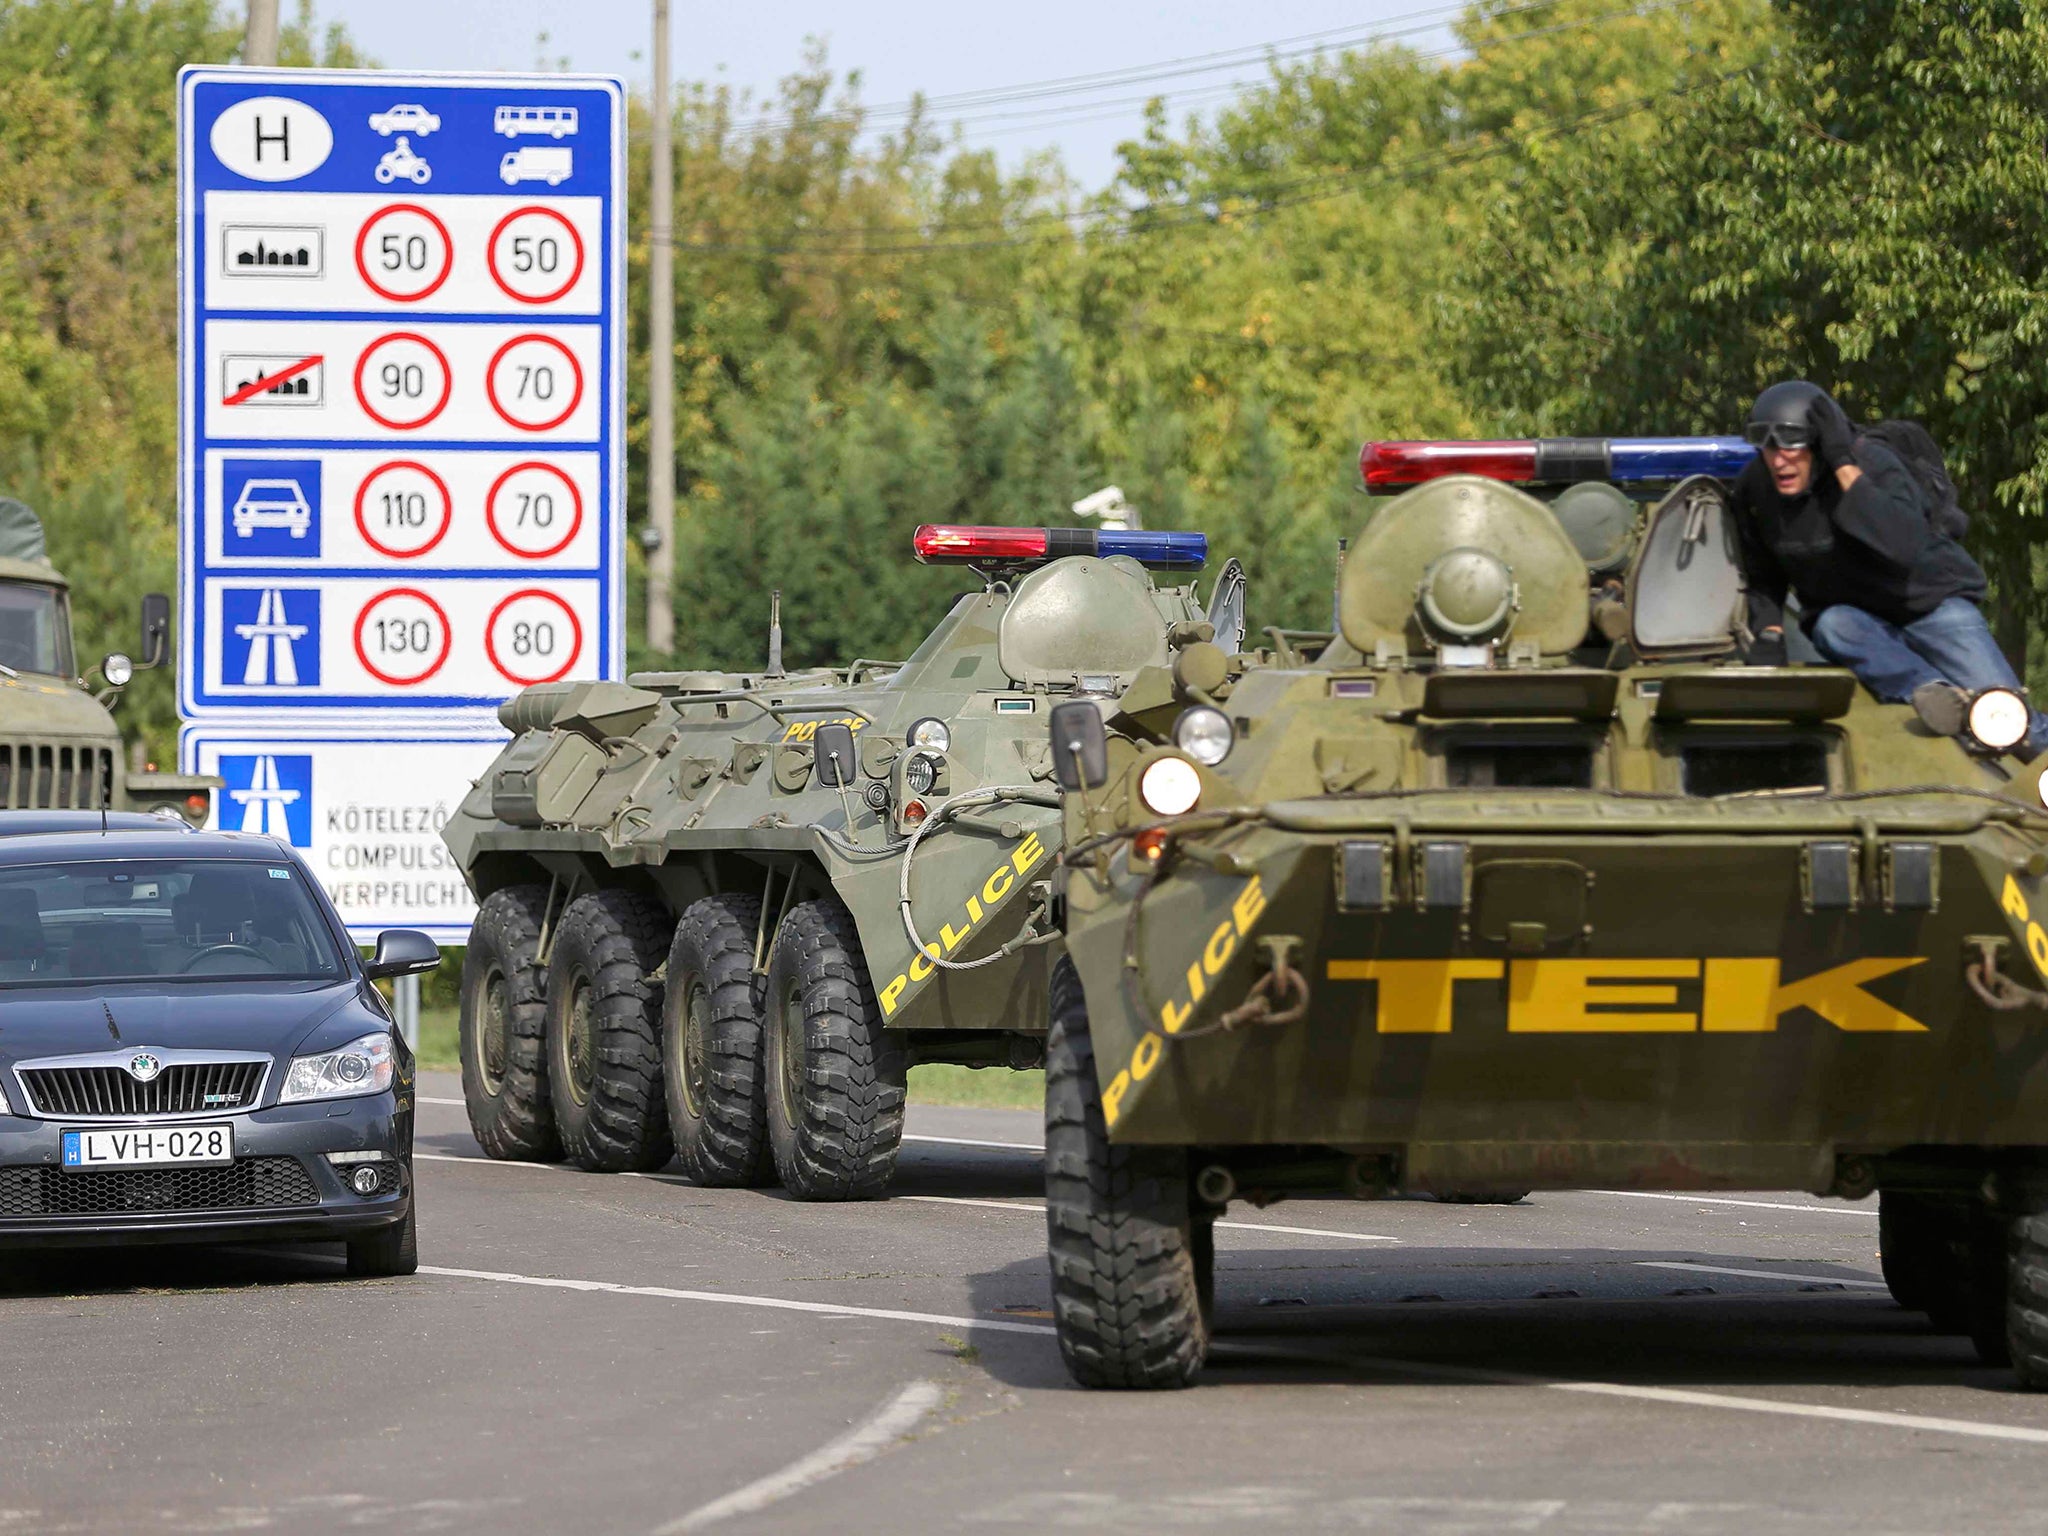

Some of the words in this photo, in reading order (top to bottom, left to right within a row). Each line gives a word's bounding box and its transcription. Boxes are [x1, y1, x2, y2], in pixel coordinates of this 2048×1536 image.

[255, 115, 289, 162] H
[381, 234, 427, 272] 50
[513, 236, 559, 273] 50
[381, 364, 423, 399] 90
[516, 366, 554, 401] 70
[381, 491, 427, 528] 110
[516, 493, 554, 529] 70
[376, 619, 430, 654] 130
[512, 622, 555, 656] 80
[879, 831, 1046, 1016] POLICE
[1101, 874, 1267, 1127] POLICE
[1327, 957, 1928, 1034] TEK
[69, 1151, 77, 1162] H
[87, 1130, 223, 1161] LVH-028
